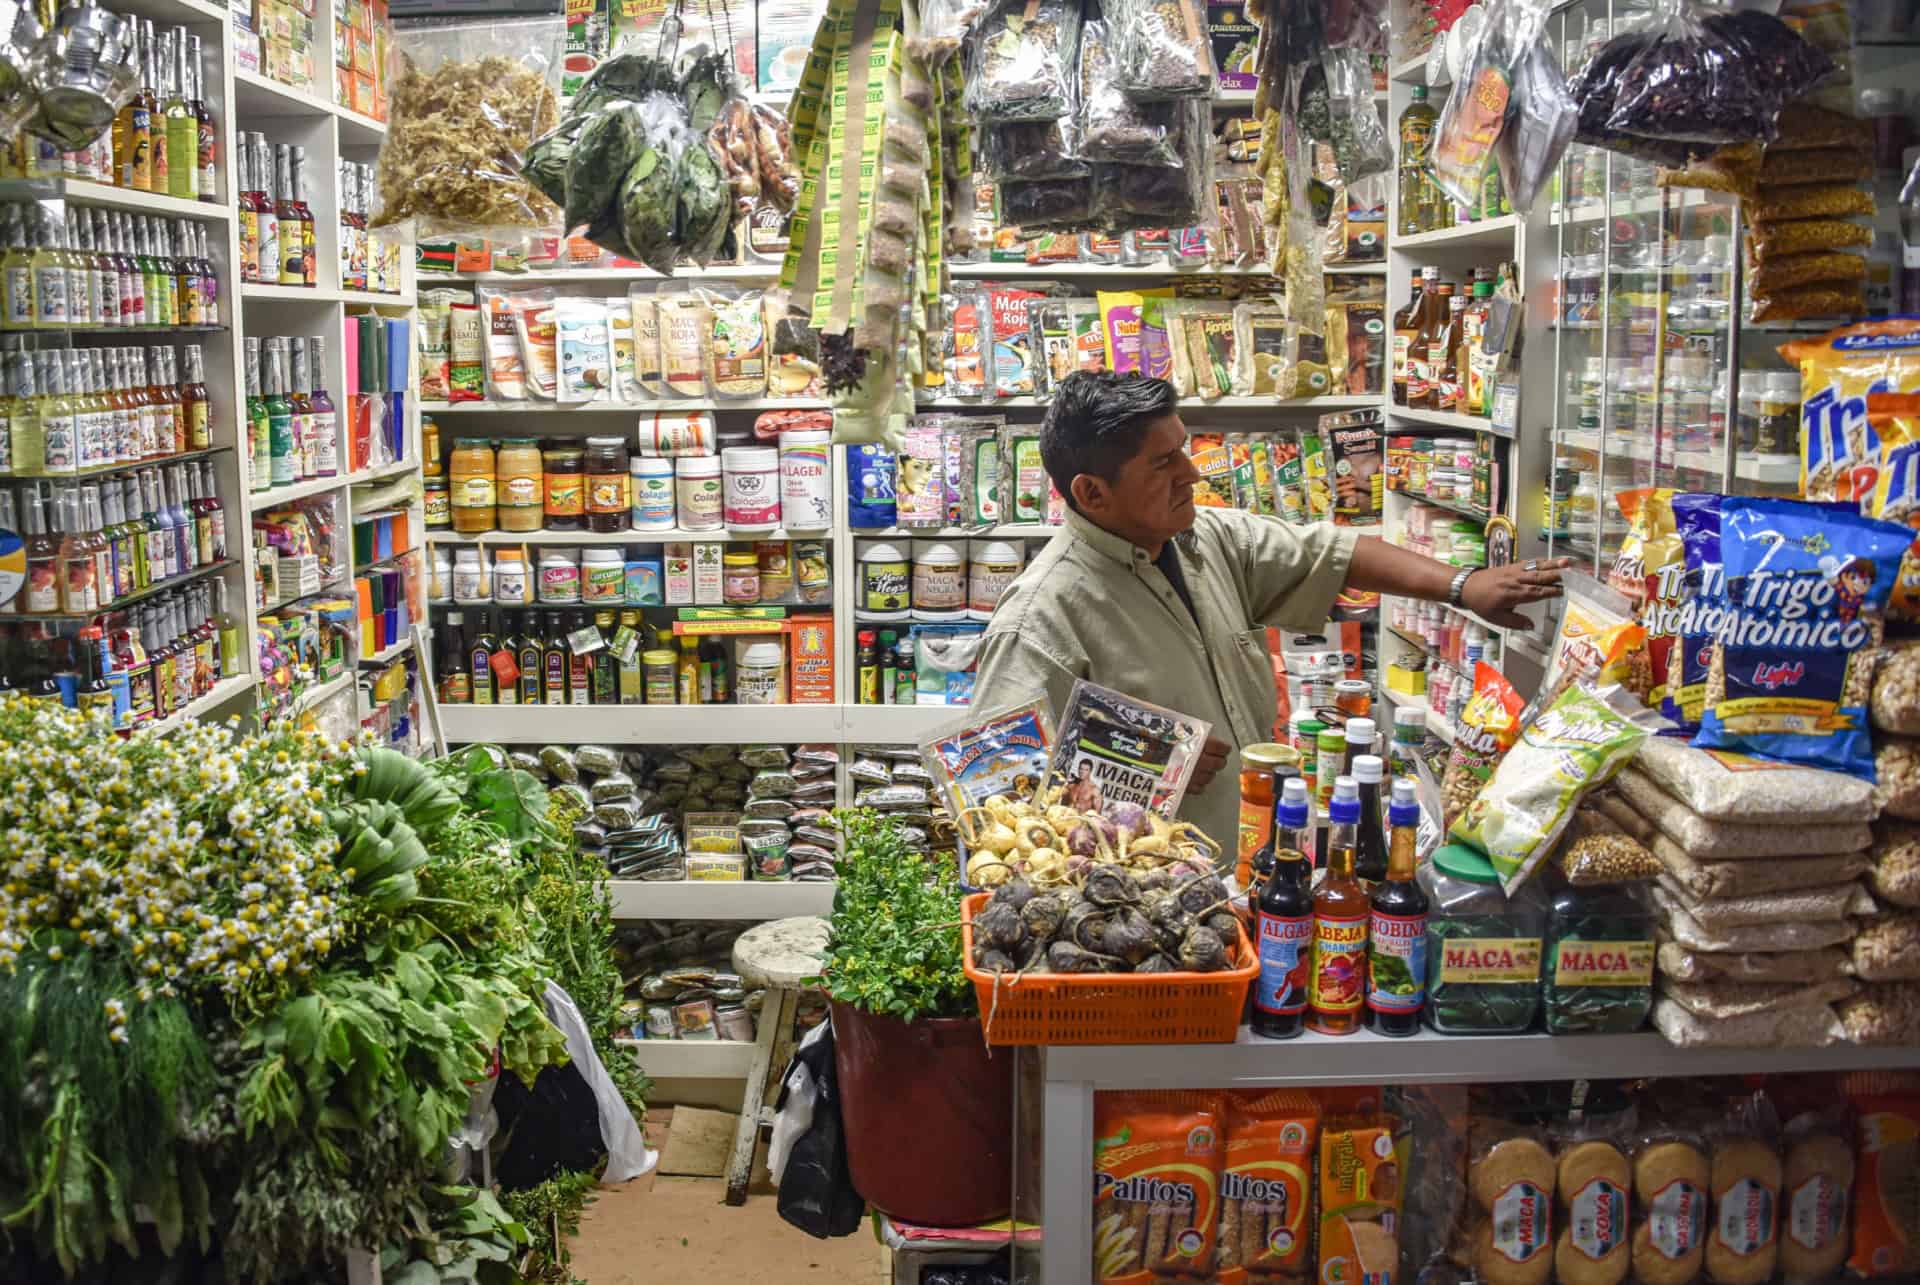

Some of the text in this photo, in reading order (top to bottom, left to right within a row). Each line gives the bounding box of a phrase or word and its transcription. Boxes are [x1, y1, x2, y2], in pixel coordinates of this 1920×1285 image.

[1745, 568, 1835, 619] Trigo
[1096, 763, 1154, 793] MACA
[1101, 784, 1150, 810] NEGRA
[1447, 951, 1513, 969] MACA
[1561, 952, 1629, 971] MACA
[1519, 1197, 1536, 1244] MACA
